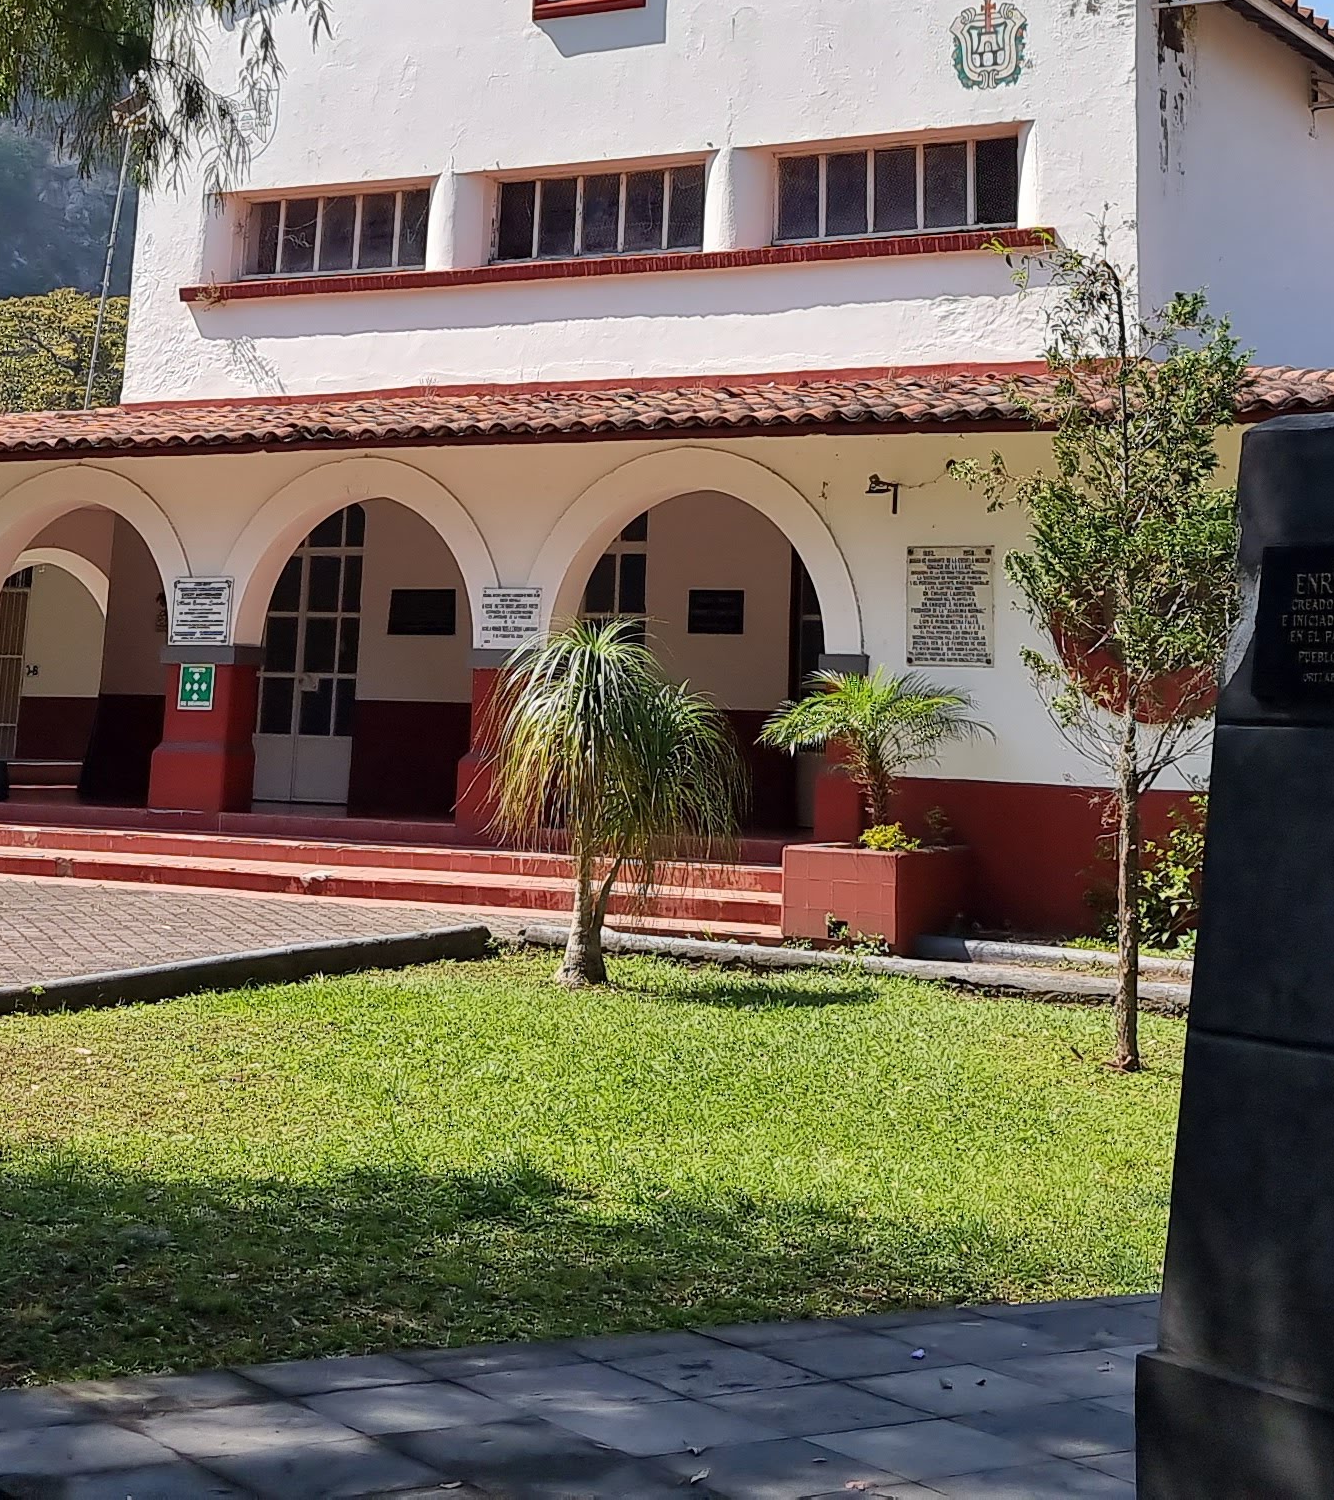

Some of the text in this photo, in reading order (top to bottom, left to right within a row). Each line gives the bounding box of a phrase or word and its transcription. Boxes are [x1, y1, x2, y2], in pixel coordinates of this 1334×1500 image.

[1281, 614, 1289, 627] E
[1290, 630, 1304, 643] EN
[1308, 630, 1320, 643] EL
